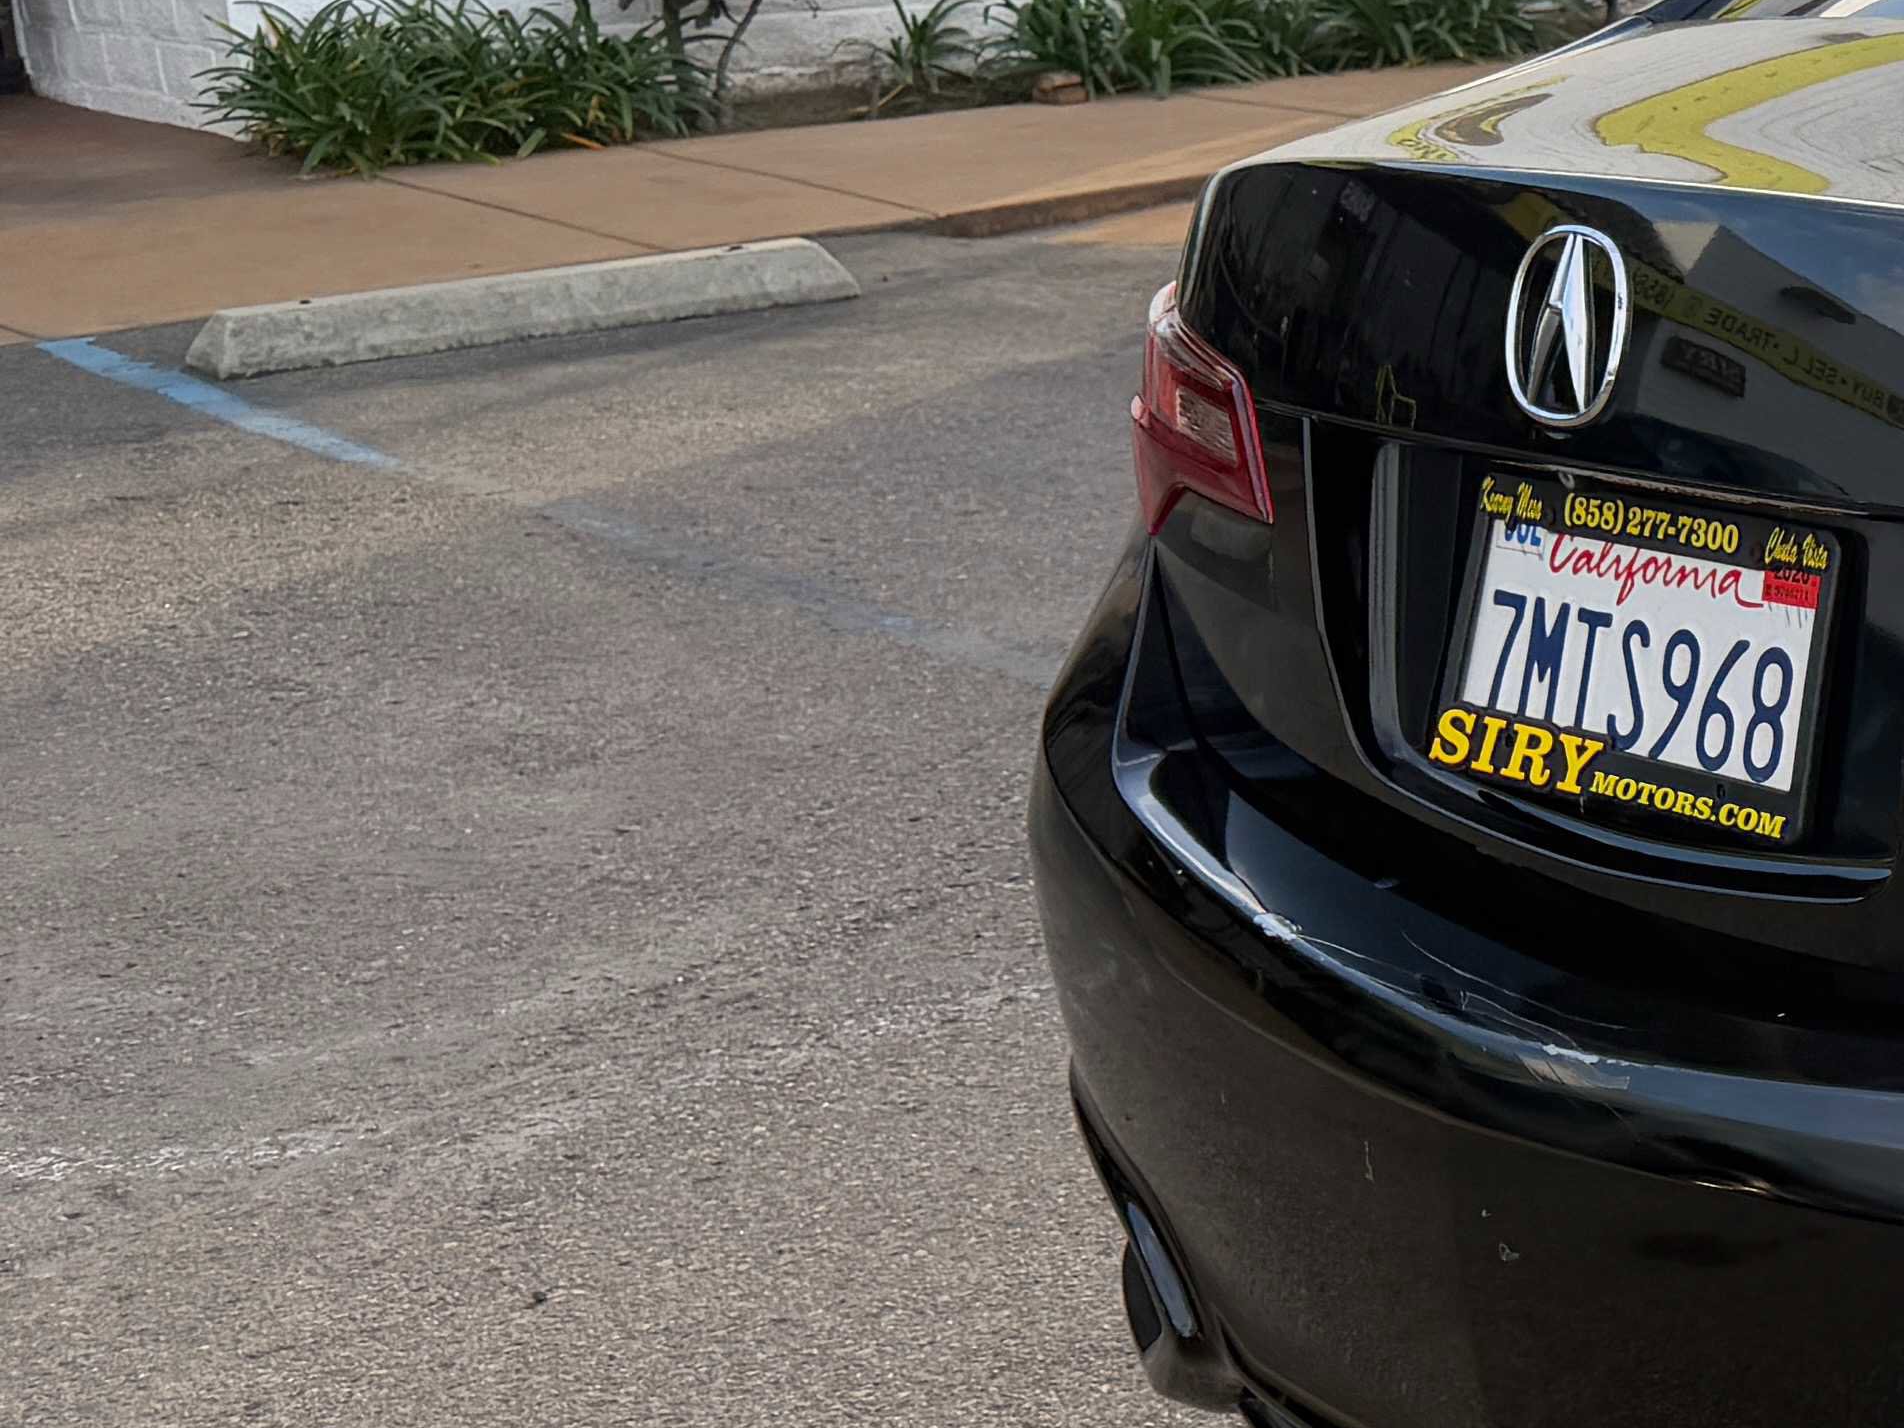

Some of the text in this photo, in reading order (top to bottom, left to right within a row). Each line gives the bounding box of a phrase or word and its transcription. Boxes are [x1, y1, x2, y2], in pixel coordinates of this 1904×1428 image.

[1564, 491, 1740, 554] (858) 277-7300
[1549, 532, 1765, 607] California
[1487, 588, 1795, 784] 7MTS968
[1427, 706, 1605, 797] SIRY
[1589, 769, 1788, 840] MOTORS.COM
